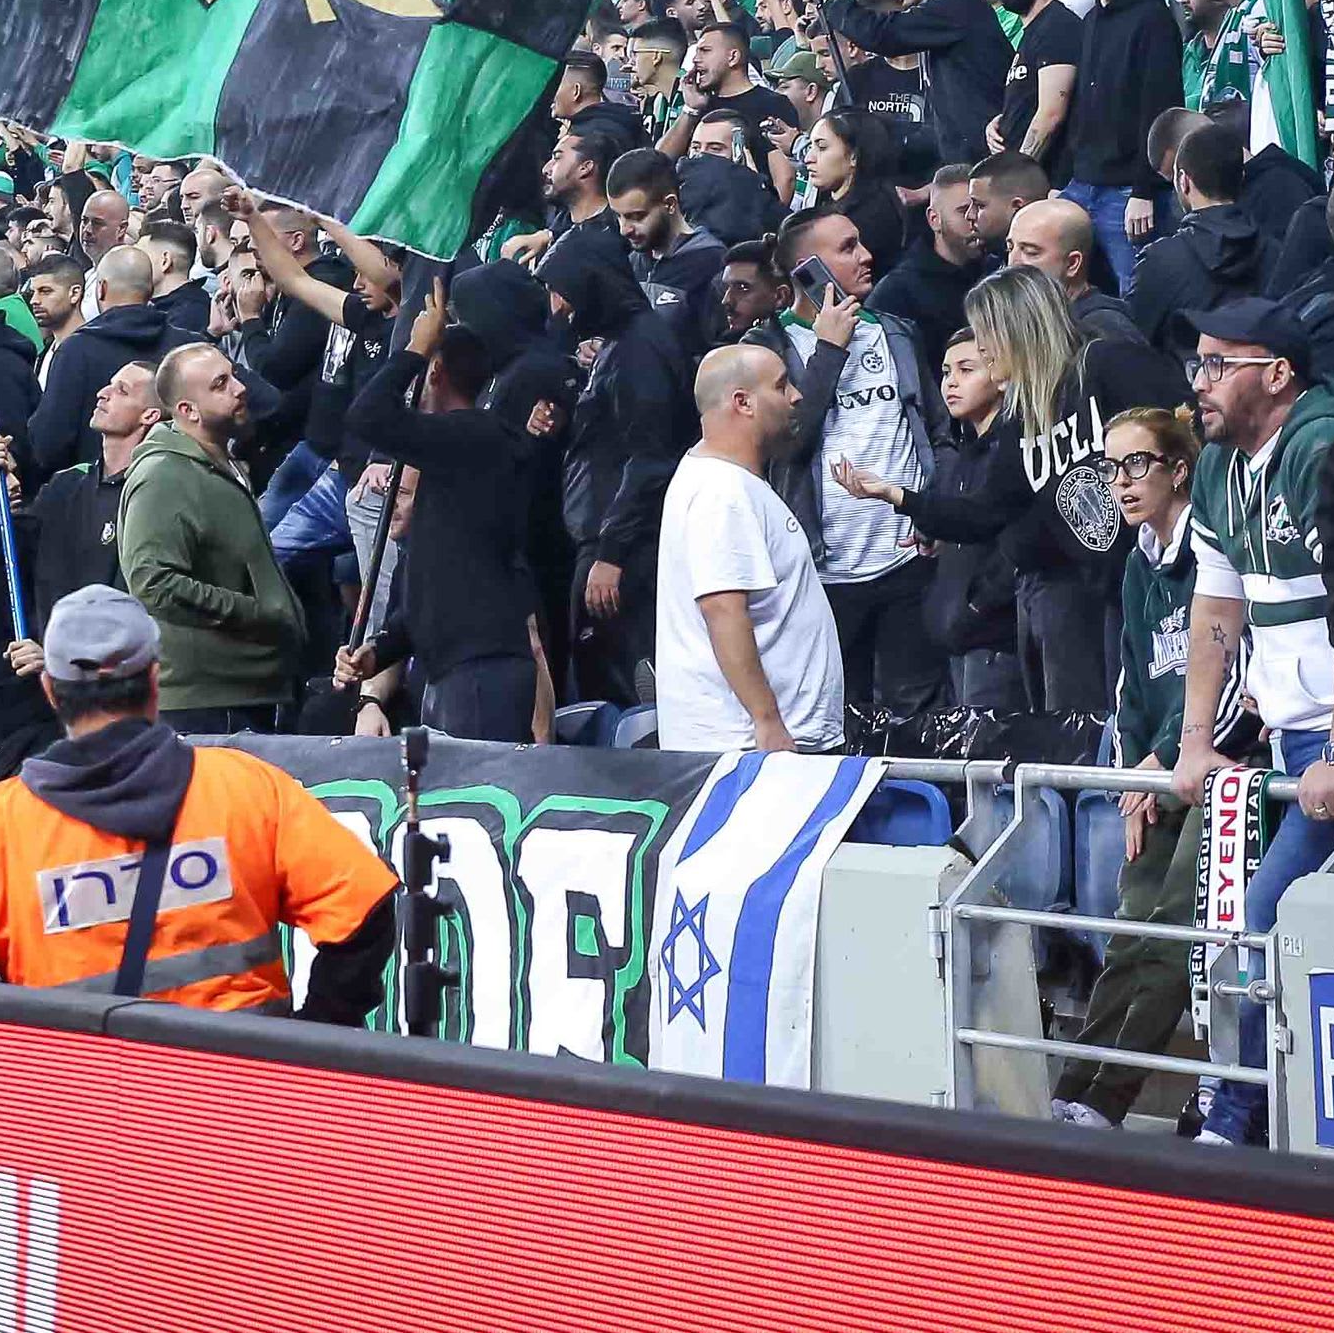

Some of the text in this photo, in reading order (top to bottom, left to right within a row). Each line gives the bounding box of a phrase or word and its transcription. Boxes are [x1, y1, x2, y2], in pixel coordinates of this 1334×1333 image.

[889, 93, 910, 103] THE
[868, 100, 910, 113] NORTH
[1196, 825, 1212, 910] LEAGUE
[1283, 936, 1301, 954] P14
